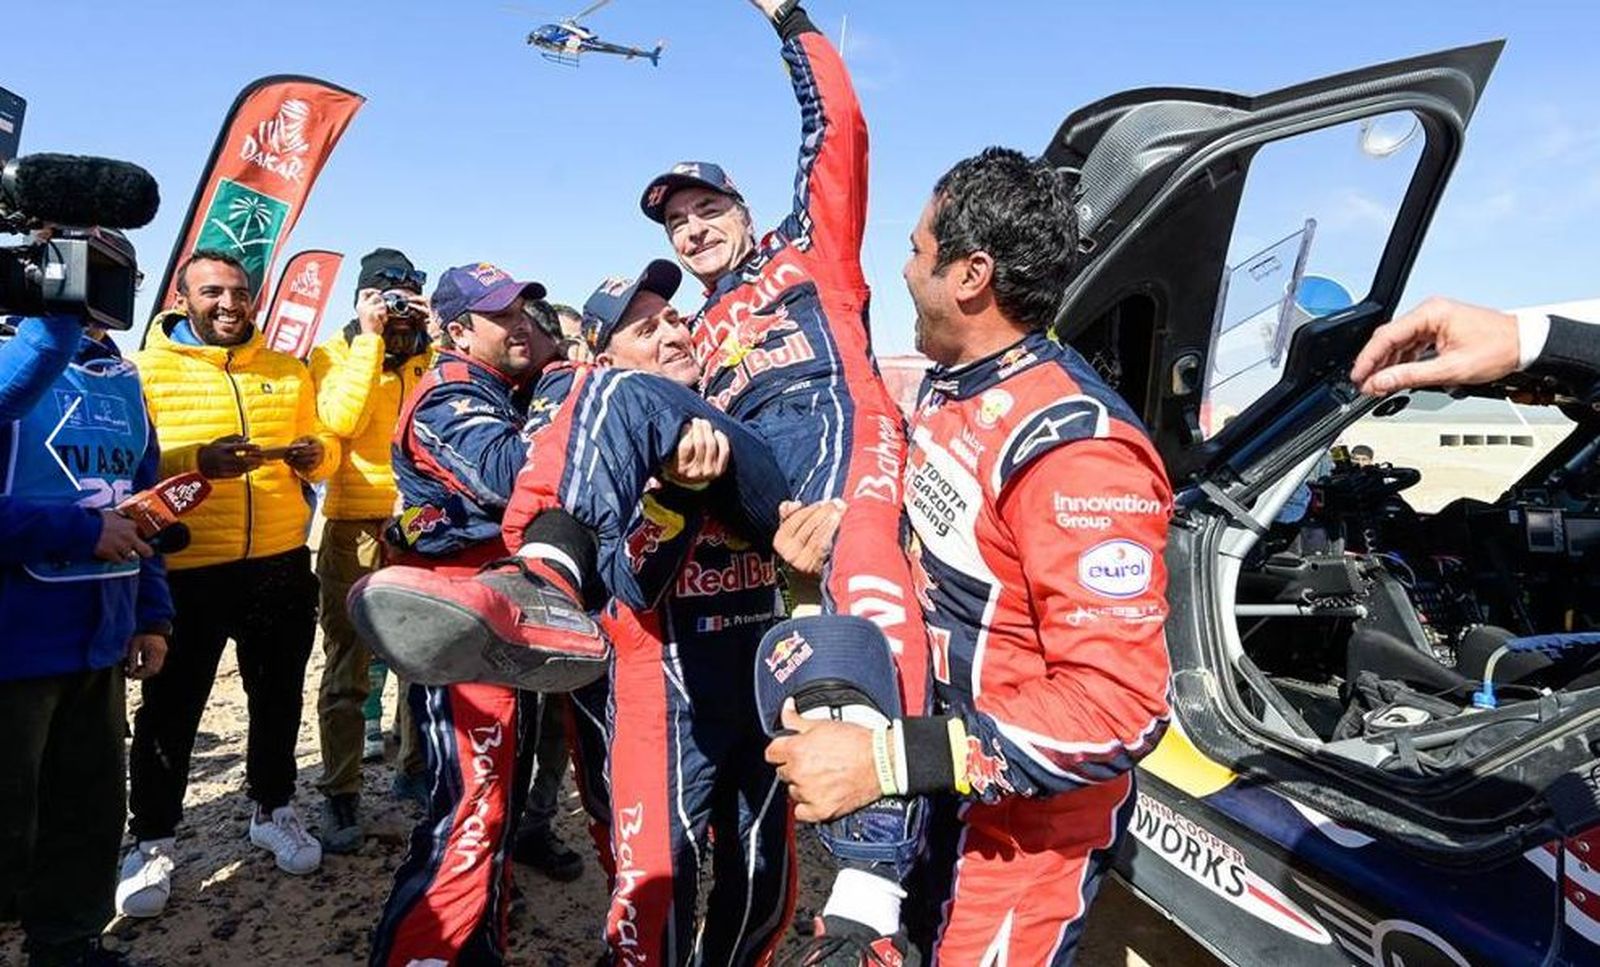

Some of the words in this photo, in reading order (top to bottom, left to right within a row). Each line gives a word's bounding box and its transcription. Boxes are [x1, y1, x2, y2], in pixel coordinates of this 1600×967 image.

[240, 132, 304, 184] DAKAR
[744, 330, 816, 378] Bull
[57, 444, 90, 473] TV
[912, 474, 956, 522] GAZOO
[922, 461, 968, 512] TOYOTA
[1053, 491, 1161, 515] Innovation
[1056, 512, 1113, 531] Group
[676, 553, 743, 598] Red
[1088, 557, 1146, 579] eurol
[1135, 803, 1246, 898] WORKS
[1140, 794, 1174, 820] OHN
[1174, 814, 1244, 867] COOPER
